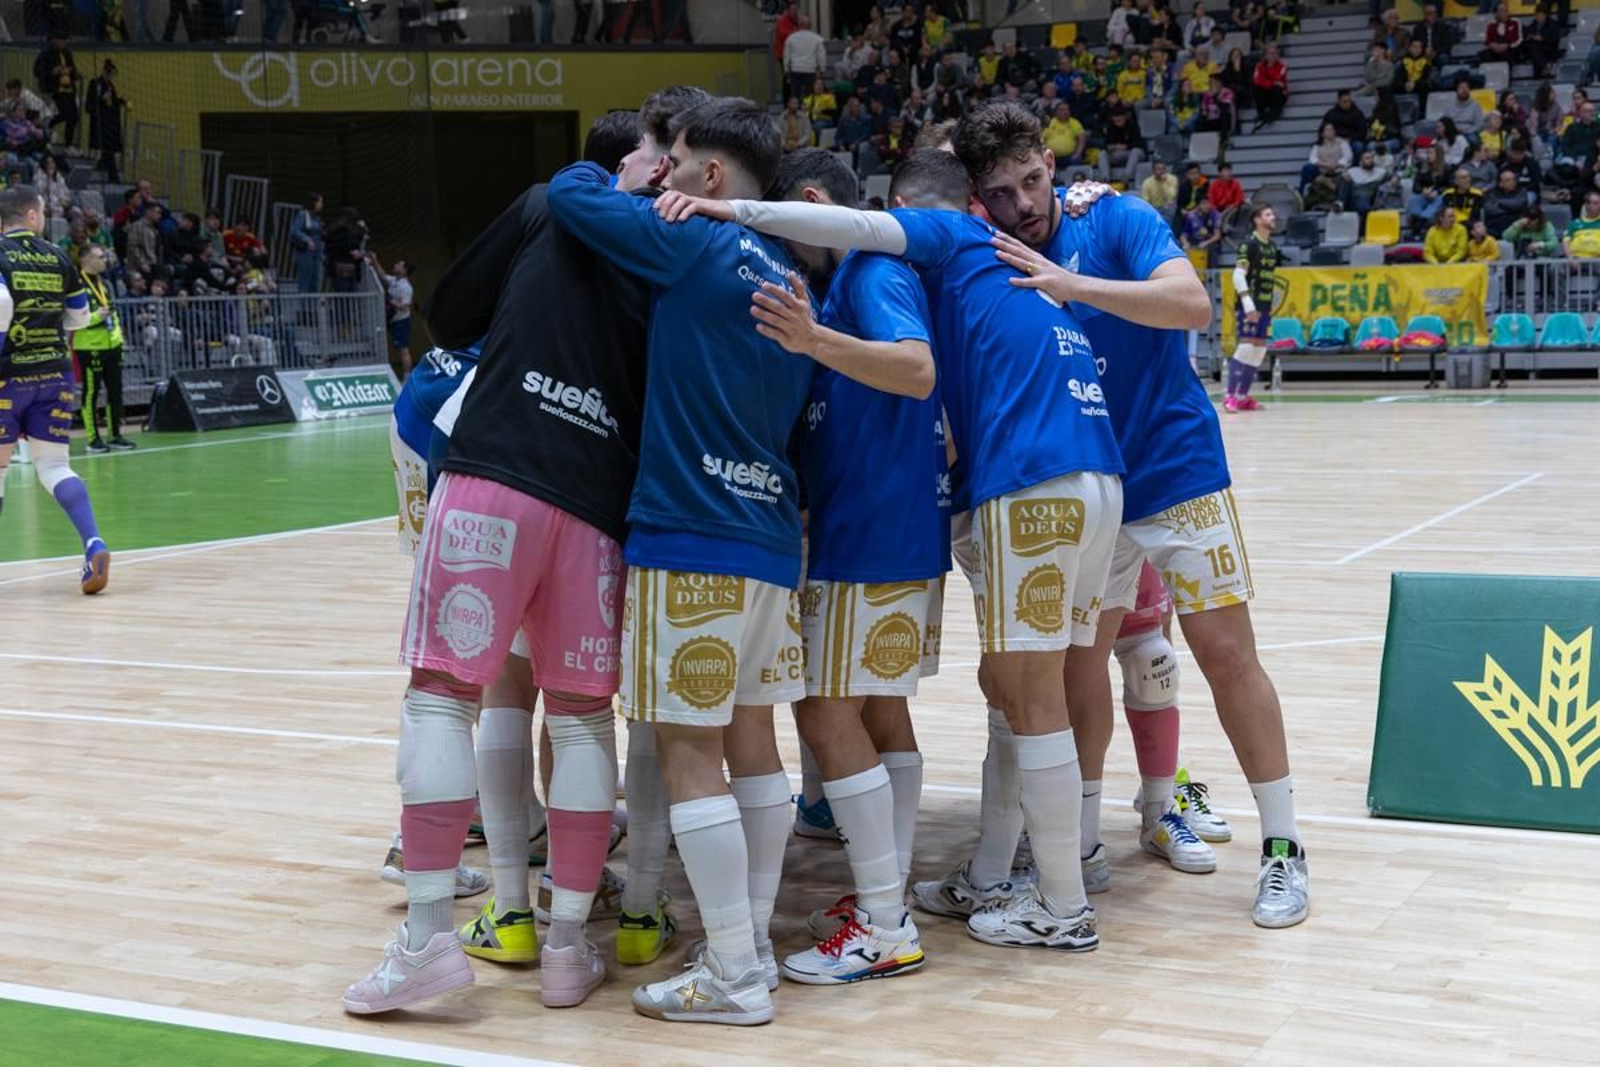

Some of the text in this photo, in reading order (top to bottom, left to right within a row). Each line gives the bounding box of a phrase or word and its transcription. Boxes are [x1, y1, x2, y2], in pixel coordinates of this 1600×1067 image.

[310, 51, 564, 88] olivo arena
[1310, 272, 1392, 312] PEÑA
[1016, 504, 1080, 519] AQUA
[448, 516, 508, 540] AQUA
[1020, 520, 1076, 535] DEUS
[1193, 517, 1225, 531] REAL
[448, 533, 503, 557] DEUS
[1204, 543, 1237, 578] 16
[673, 574, 739, 588] AQUA
[676, 590, 737, 605] DEUS
[875, 633, 912, 650] INVIRPA
[564, 650, 587, 671] EL
[682, 659, 728, 676] INVIRPA
[760, 667, 782, 684] EL
